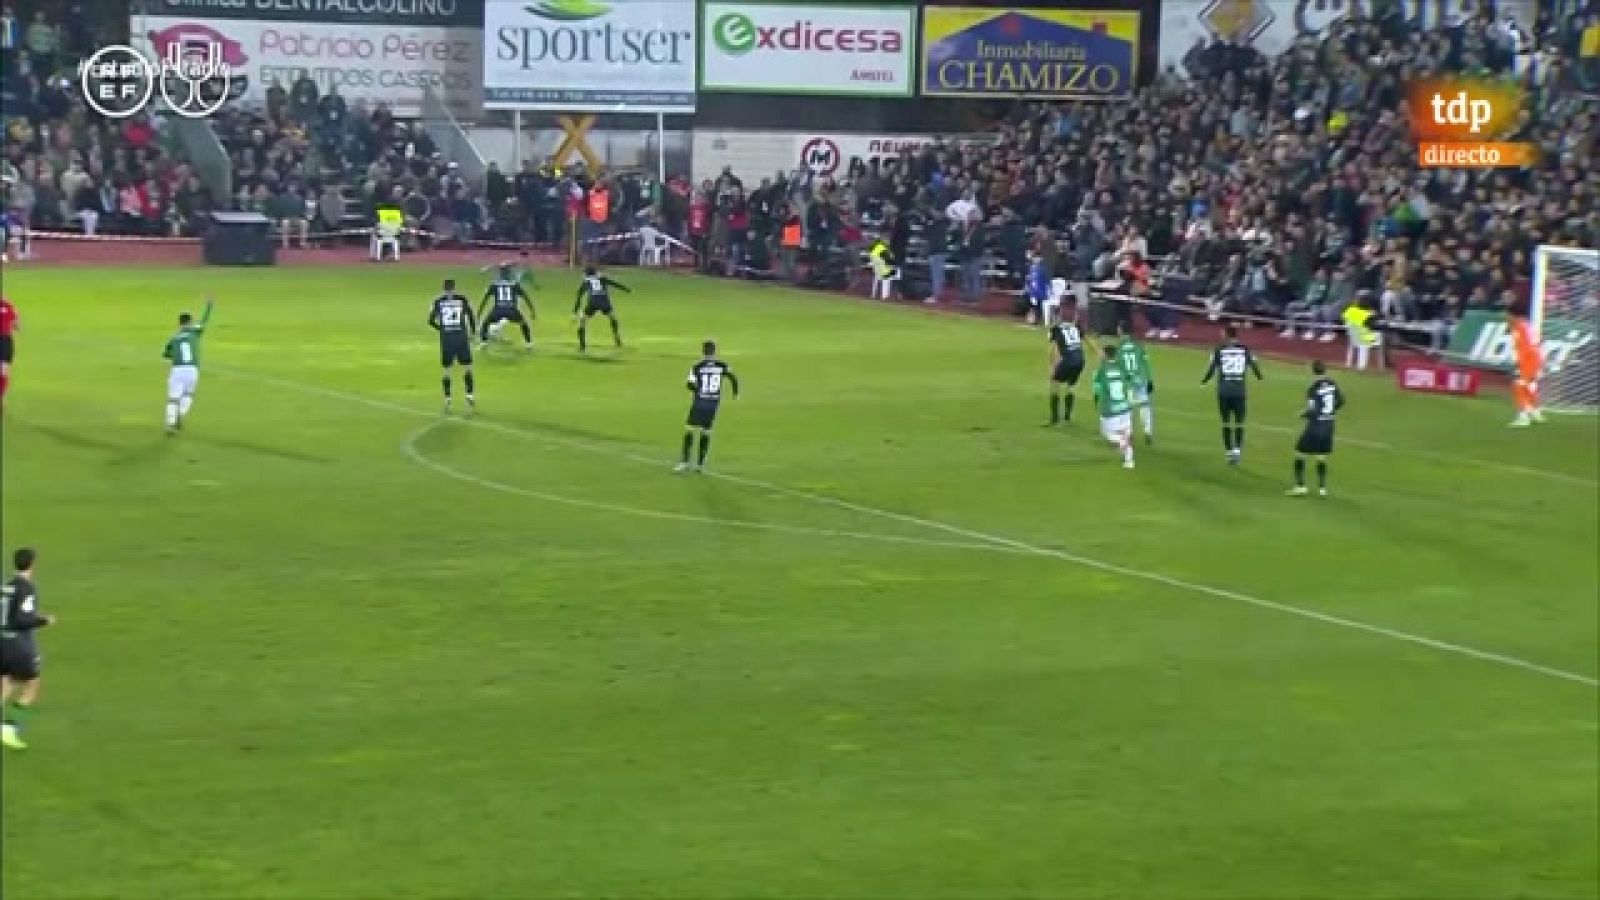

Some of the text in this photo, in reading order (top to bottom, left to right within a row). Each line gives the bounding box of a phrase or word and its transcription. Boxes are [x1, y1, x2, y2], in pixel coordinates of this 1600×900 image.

[259, 29, 375, 60] Patricio
[497, 22, 691, 71] sportser
[976, 39, 1087, 61] Inmobiliaria
[939, 59, 1119, 93] CHAMIZO
